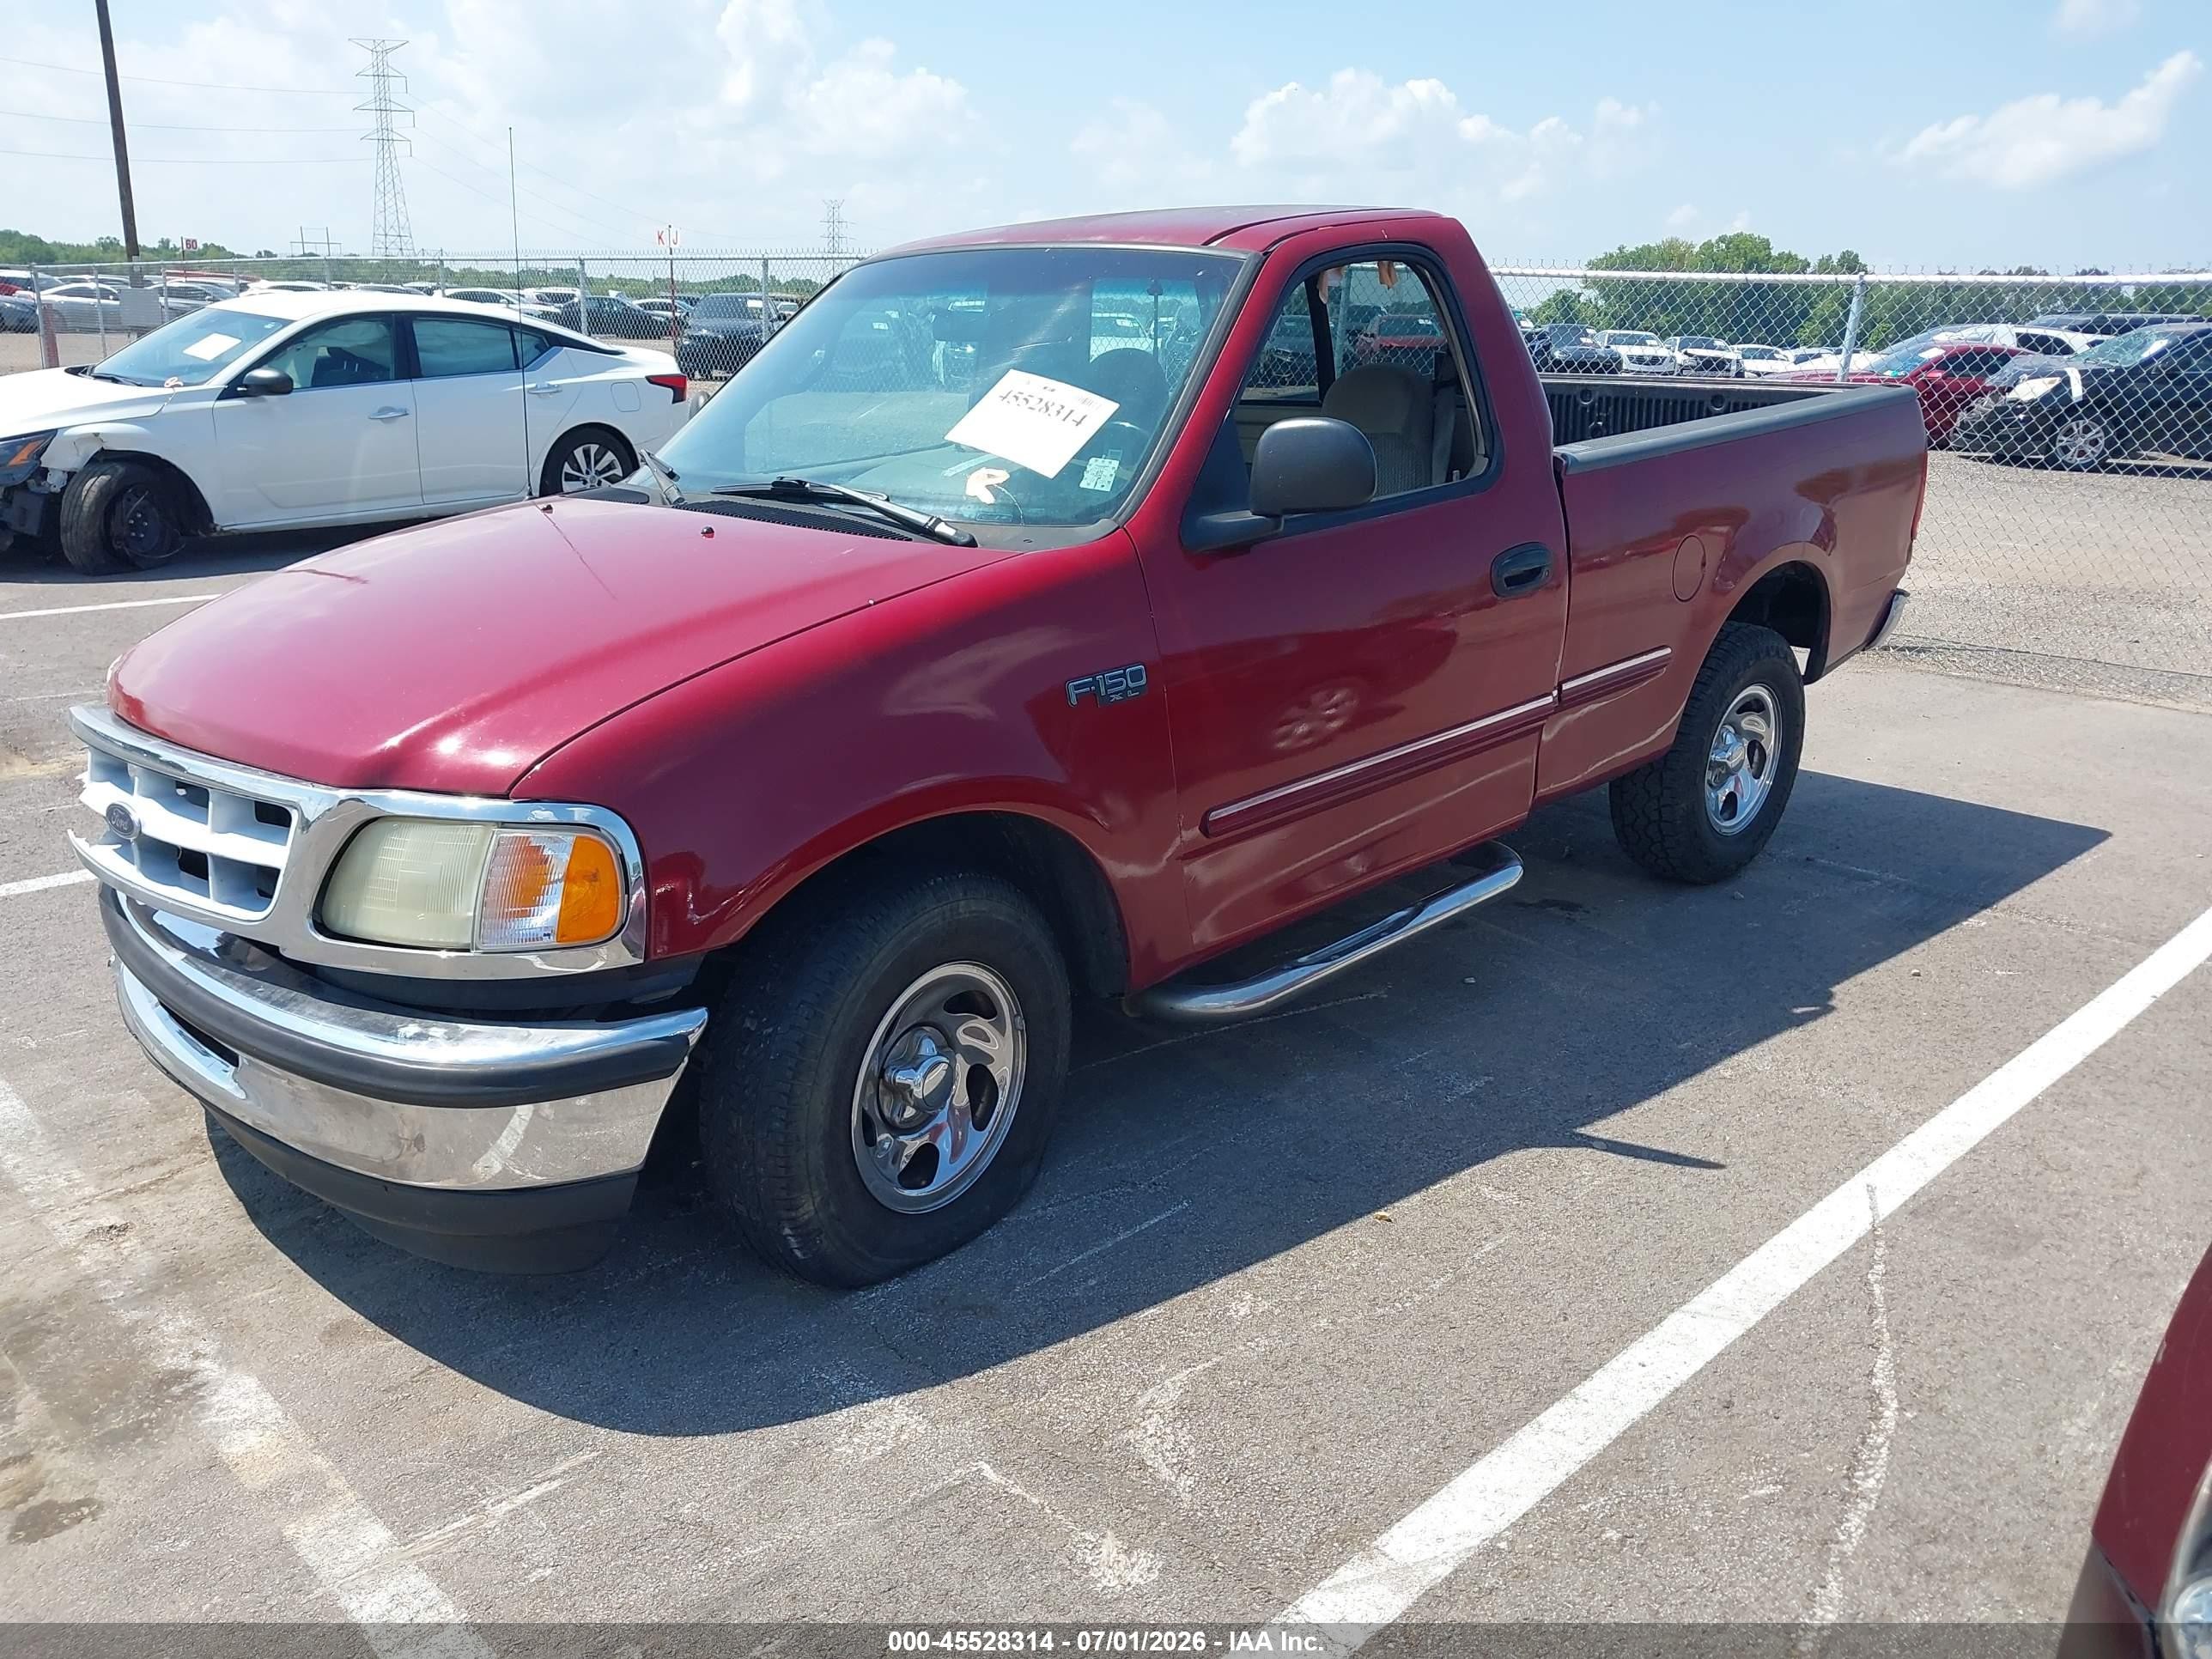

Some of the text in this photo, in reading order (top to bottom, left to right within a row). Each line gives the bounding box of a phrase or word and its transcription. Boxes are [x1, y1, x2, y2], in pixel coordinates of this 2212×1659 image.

[185, 239, 198, 250] 60
[657, 230, 665, 246] K
[672, 230, 678, 246] J
[999, 389, 1088, 427] 45528314
[1109, 690, 1140, 702] XL
